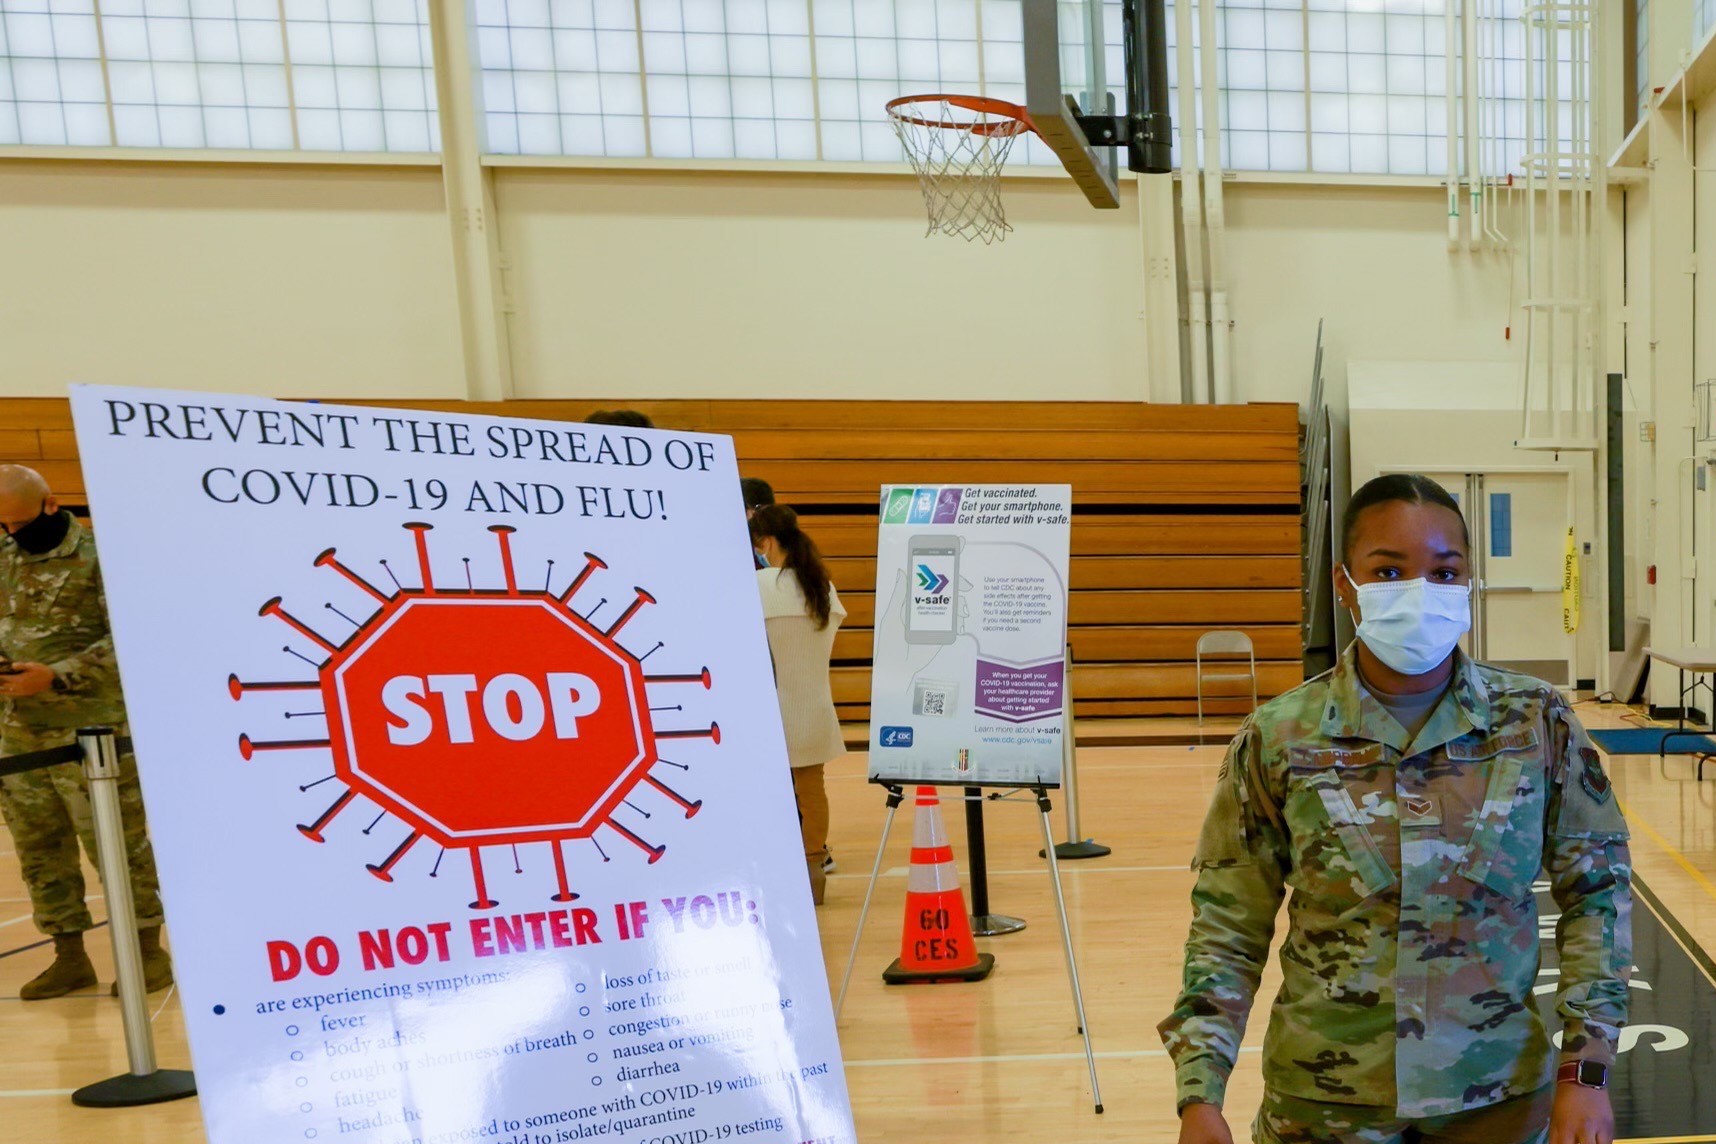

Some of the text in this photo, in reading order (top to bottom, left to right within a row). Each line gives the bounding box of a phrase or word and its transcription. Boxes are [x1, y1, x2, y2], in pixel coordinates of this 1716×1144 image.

[103, 399, 715, 471] PREVENT THE SPREAD OF
[202, 466, 667, 520] COVID-19 AND FLU!
[964, 487, 1038, 498] Get vaccinated.
[961, 500, 1063, 513] Get your smartphone.
[957, 514, 1070, 525] Get started with v-safe.
[1565, 554, 1573, 590] CAUTION
[914, 595, 950, 605] v-safe
[1010, 672, 1022, 680] you
[1022, 672, 1033, 680] get
[1033, 672, 1048, 680] your
[381, 672, 601, 746] STOP
[974, 725, 994, 733] Learn
[1014, 725, 1035, 733] about
[1037, 726, 1061, 734] v-safe
[920, 909, 949, 930] 60
[266, 891, 759, 983] DO NOT ENTER IF YOU:
[915, 938, 958, 961] CES
[605, 974, 633, 990] loss
[637, 968, 655, 984] of
[657, 967, 690, 981] taste
[256, 971, 510, 1015] are experiencing symptoms:
[604, 991, 686, 1013] sore throat
[320, 1013, 366, 1032] fever
[608, 1013, 690, 1036] congestion
[324, 1030, 426, 1058] body aches
[612, 1026, 754, 1060] nausea or vomiting
[330, 1060, 386, 1082] cough
[419, 1046, 499, 1068] shortness
[503, 1040, 521, 1055] of
[524, 1030, 577, 1052] breath
[616, 1060, 680, 1082] diarrhea
[334, 1084, 397, 1108] fatigue
[503, 1118, 520, 1132] to
[525, 1104, 597, 1128] someone
[601, 1095, 636, 1114] with
[640, 1080, 722, 1108] COVID-19
[726, 1072, 772, 1091] within
[801, 1062, 828, 1082] past
[338, 1103, 424, 1133] headache
[556, 1105, 696, 1144] isolate/quarantine
[735, 1116, 784, 1136] testing
